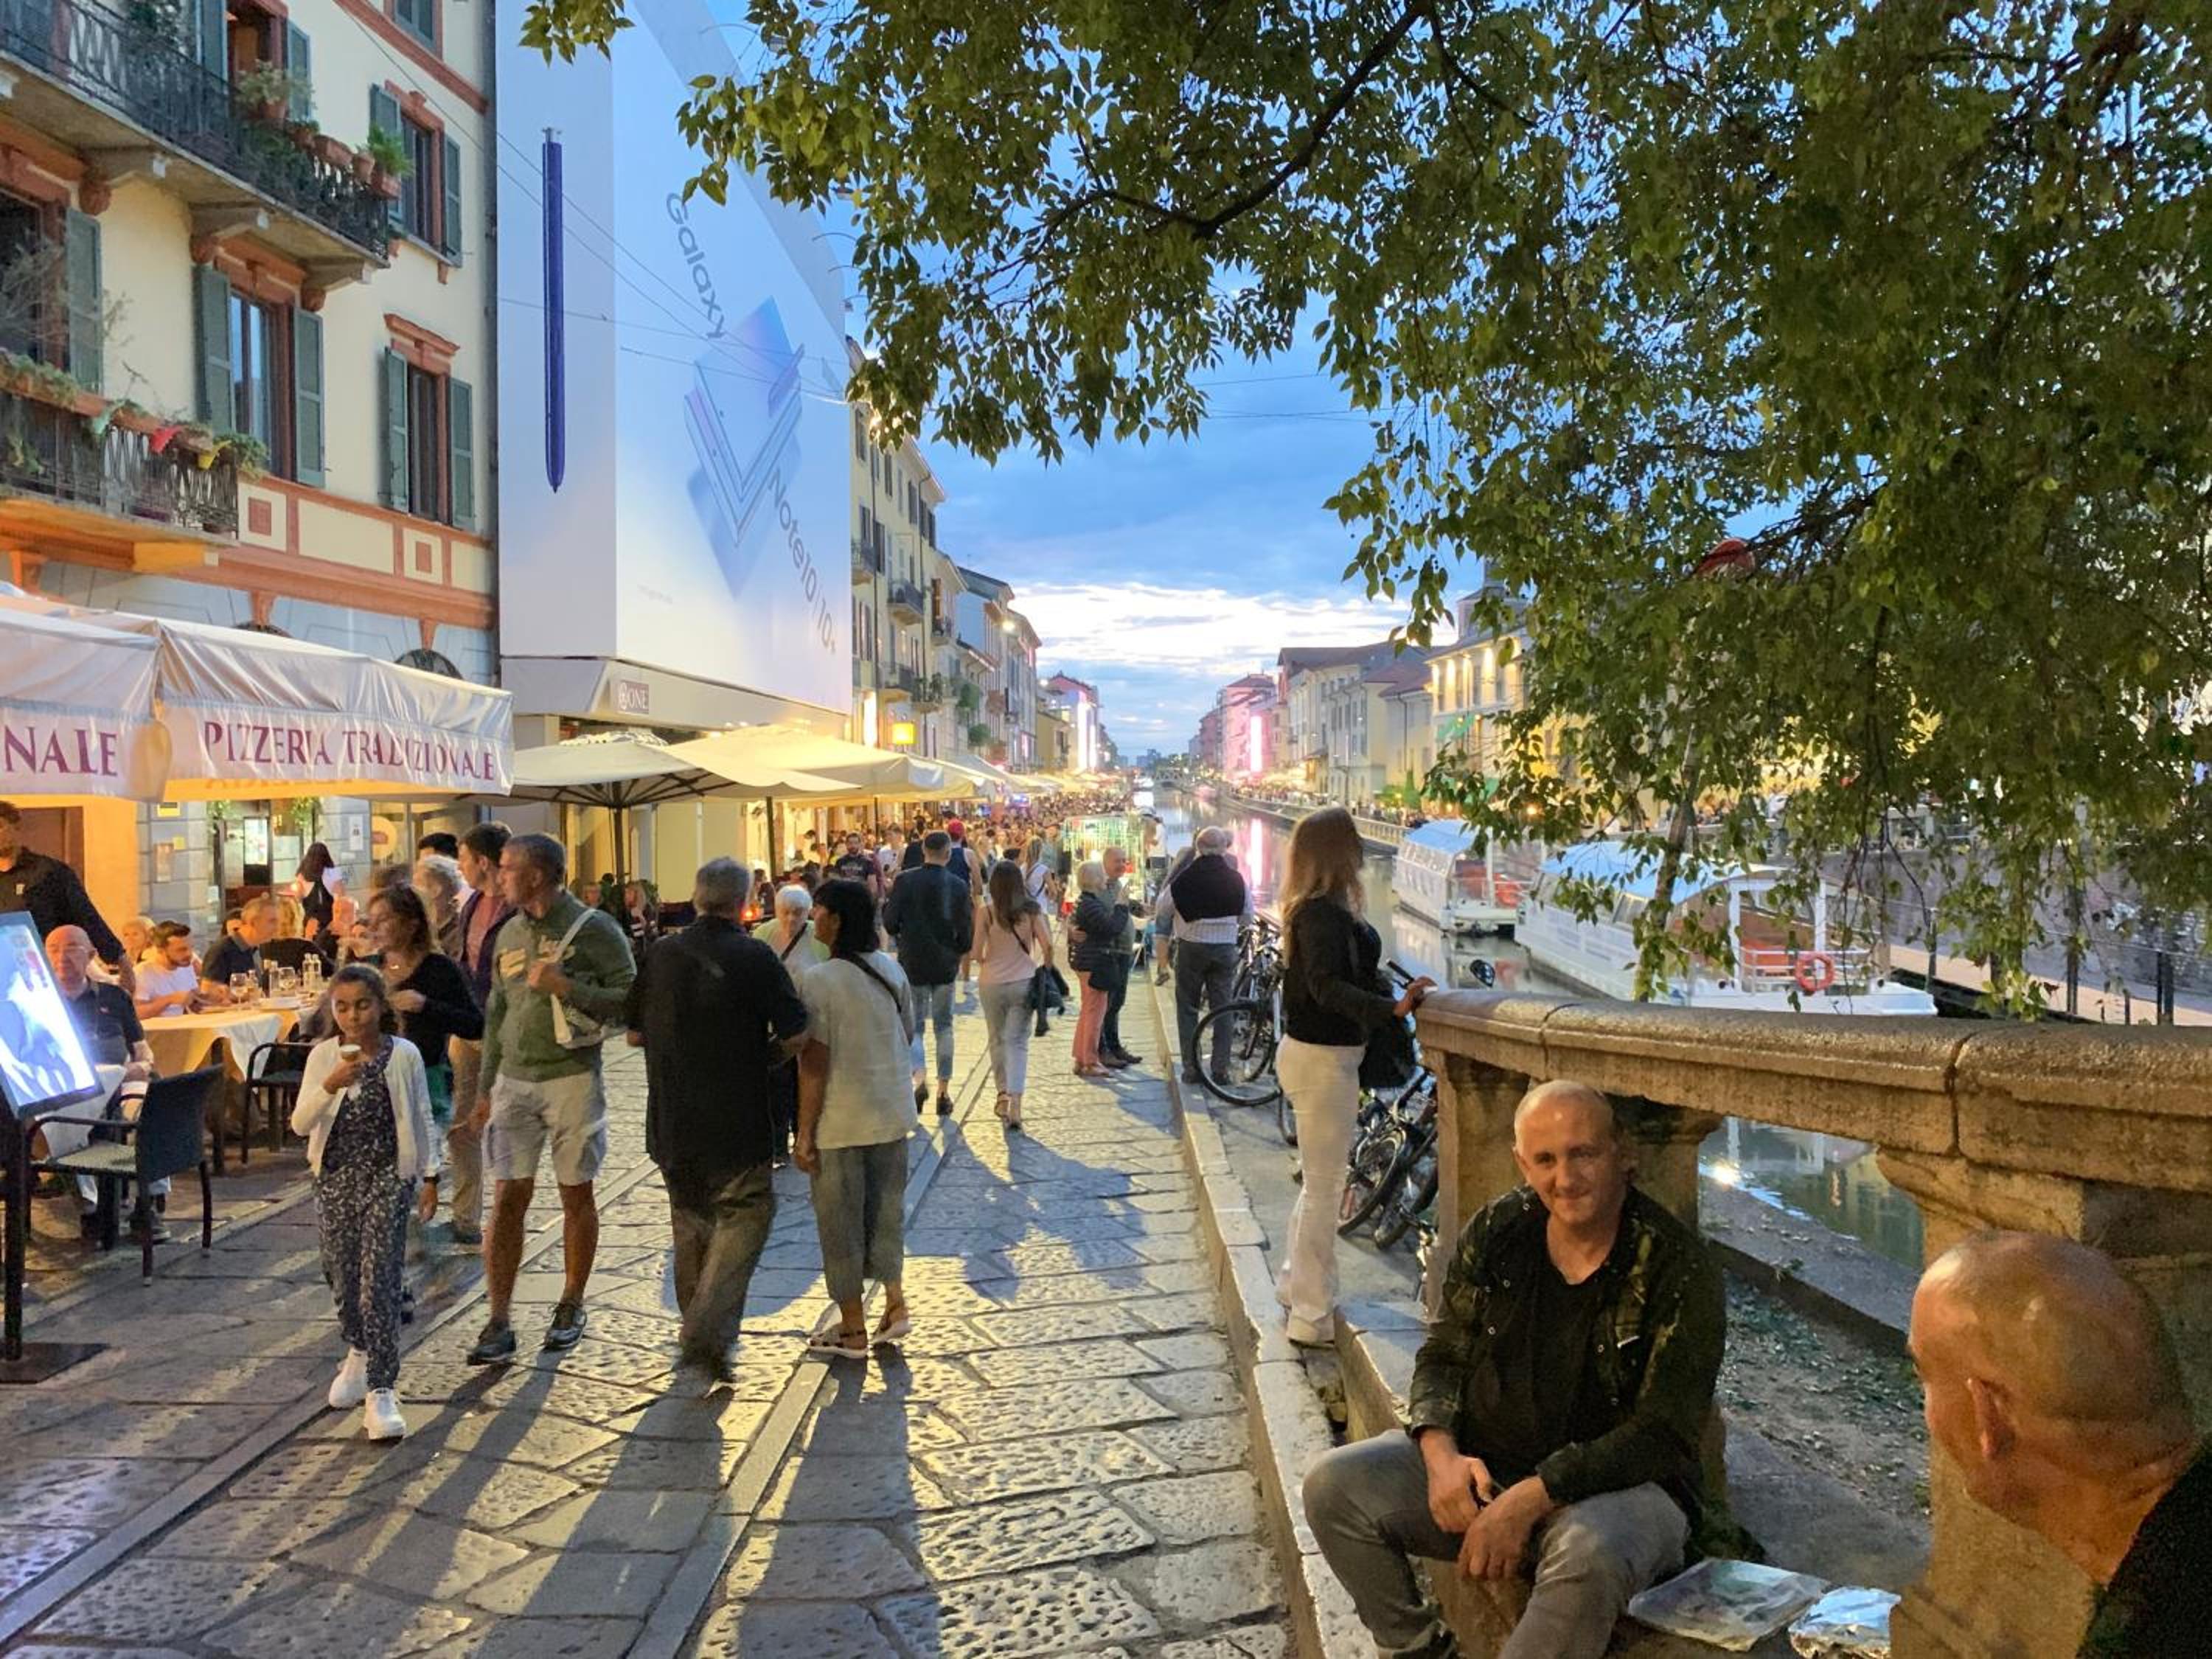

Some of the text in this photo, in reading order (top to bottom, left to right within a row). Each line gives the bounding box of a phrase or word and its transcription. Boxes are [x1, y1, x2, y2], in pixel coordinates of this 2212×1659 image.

[666, 192, 725, 338] Galaxy
[4, 725, 118, 777] NALE
[204, 722, 333, 765] PIZZERIA
